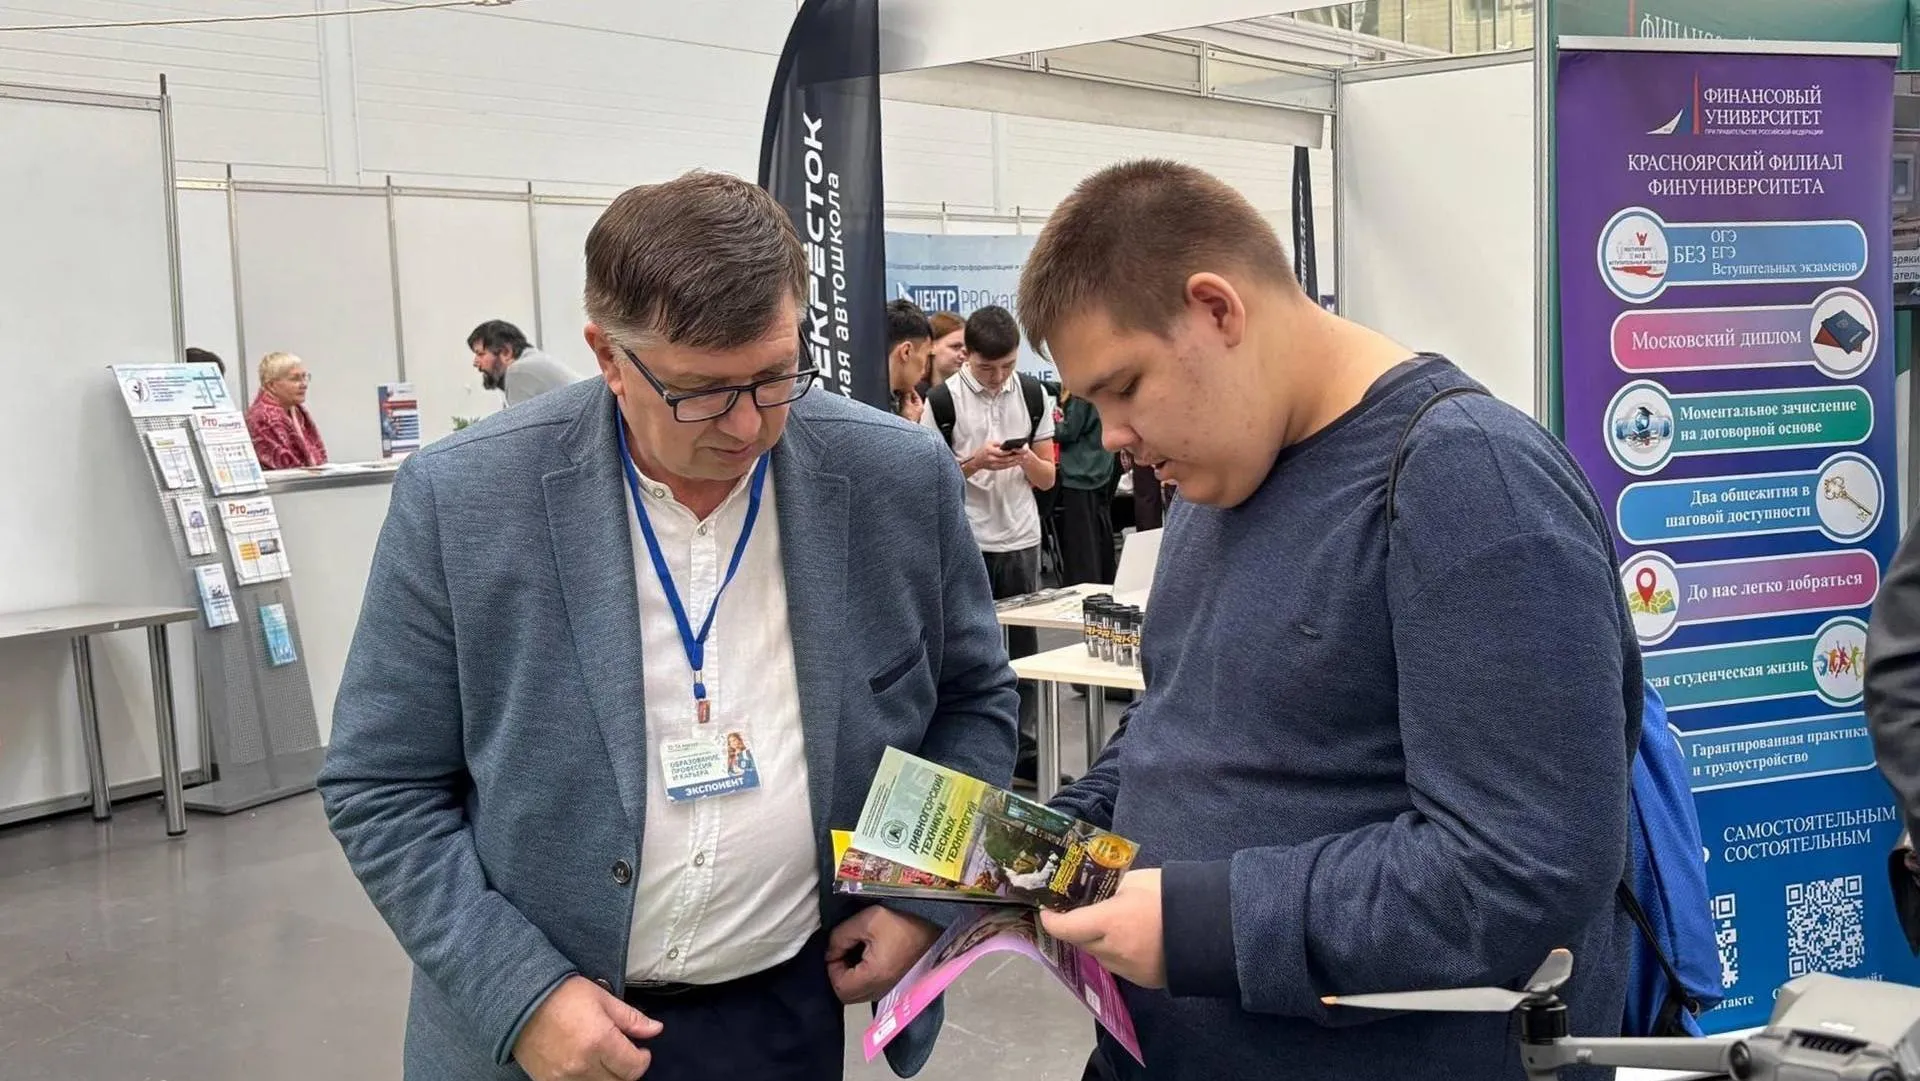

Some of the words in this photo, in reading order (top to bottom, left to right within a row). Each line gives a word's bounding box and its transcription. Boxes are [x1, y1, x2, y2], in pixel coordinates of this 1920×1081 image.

[1704, 84, 1822, 104] ФИНАНСОВЫЙ
[1705, 109, 1823, 126] УНИВЕРСИТЕТ
[1628, 150, 1764, 171] КРАСНОЯРСКИЙ
[1769, 154, 1843, 171] ФИЛИАЛ
[1649, 177, 1825, 196] ФИНУНИВЕРСИТЕТА
[827, 171, 850, 342] автошкола
[1673, 245, 1706, 263] БЕЗ
[1711, 229, 1737, 243] ОГЭ
[1712, 245, 1736, 259] ЕГЭ
[1712, 262, 1797, 277] Вступительных
[1799, 261, 1858, 273] экзаменов
[1631, 329, 1735, 350] Московский
[1740, 330, 1802, 347] диплом
[1679, 403, 1779, 421] Моментальное
[1781, 399, 1857, 415] зачисление
[1680, 430, 1697, 442] на
[1699, 423, 1775, 442] договорной
[1778, 422, 1823, 434] основе
[1690, 490, 1718, 506] Два
[1720, 486, 1798, 504] общежития
[1801, 486, 1810, 497] в
[1665, 510, 1724, 528] шаговой
[1727, 506, 1811, 526] доступности
[1687, 584, 1707, 603] До
[1712, 584, 1737, 598] нас
[1741, 581, 1783, 596] легко
[1786, 572, 1863, 594] добраться
[1673, 663, 1764, 688] студенческая
[1766, 660, 1809, 675] жизнь
[1691, 733, 1804, 758] Гарантированная
[1807, 726, 1868, 745] практика
[1692, 765, 1701, 776] и
[1703, 751, 1809, 778] трудоустройство
[684, 777, 744, 796] ЭКСПОНЕНТ
[908, 773, 945, 855] ДИВНОГОРСКИЙ
[1723, 804, 1896, 843] САМОСТОЯТЕЛЬНЫМ
[920, 802, 947, 856] ТЕХНИКУМ
[933, 816, 957, 862] ЛЕСНЫХ
[945, 800, 977, 863] ТЕХНОЛОГИЙ
[1724, 828, 1872, 863] СОСТОЯТЕЛЬНЫМ
